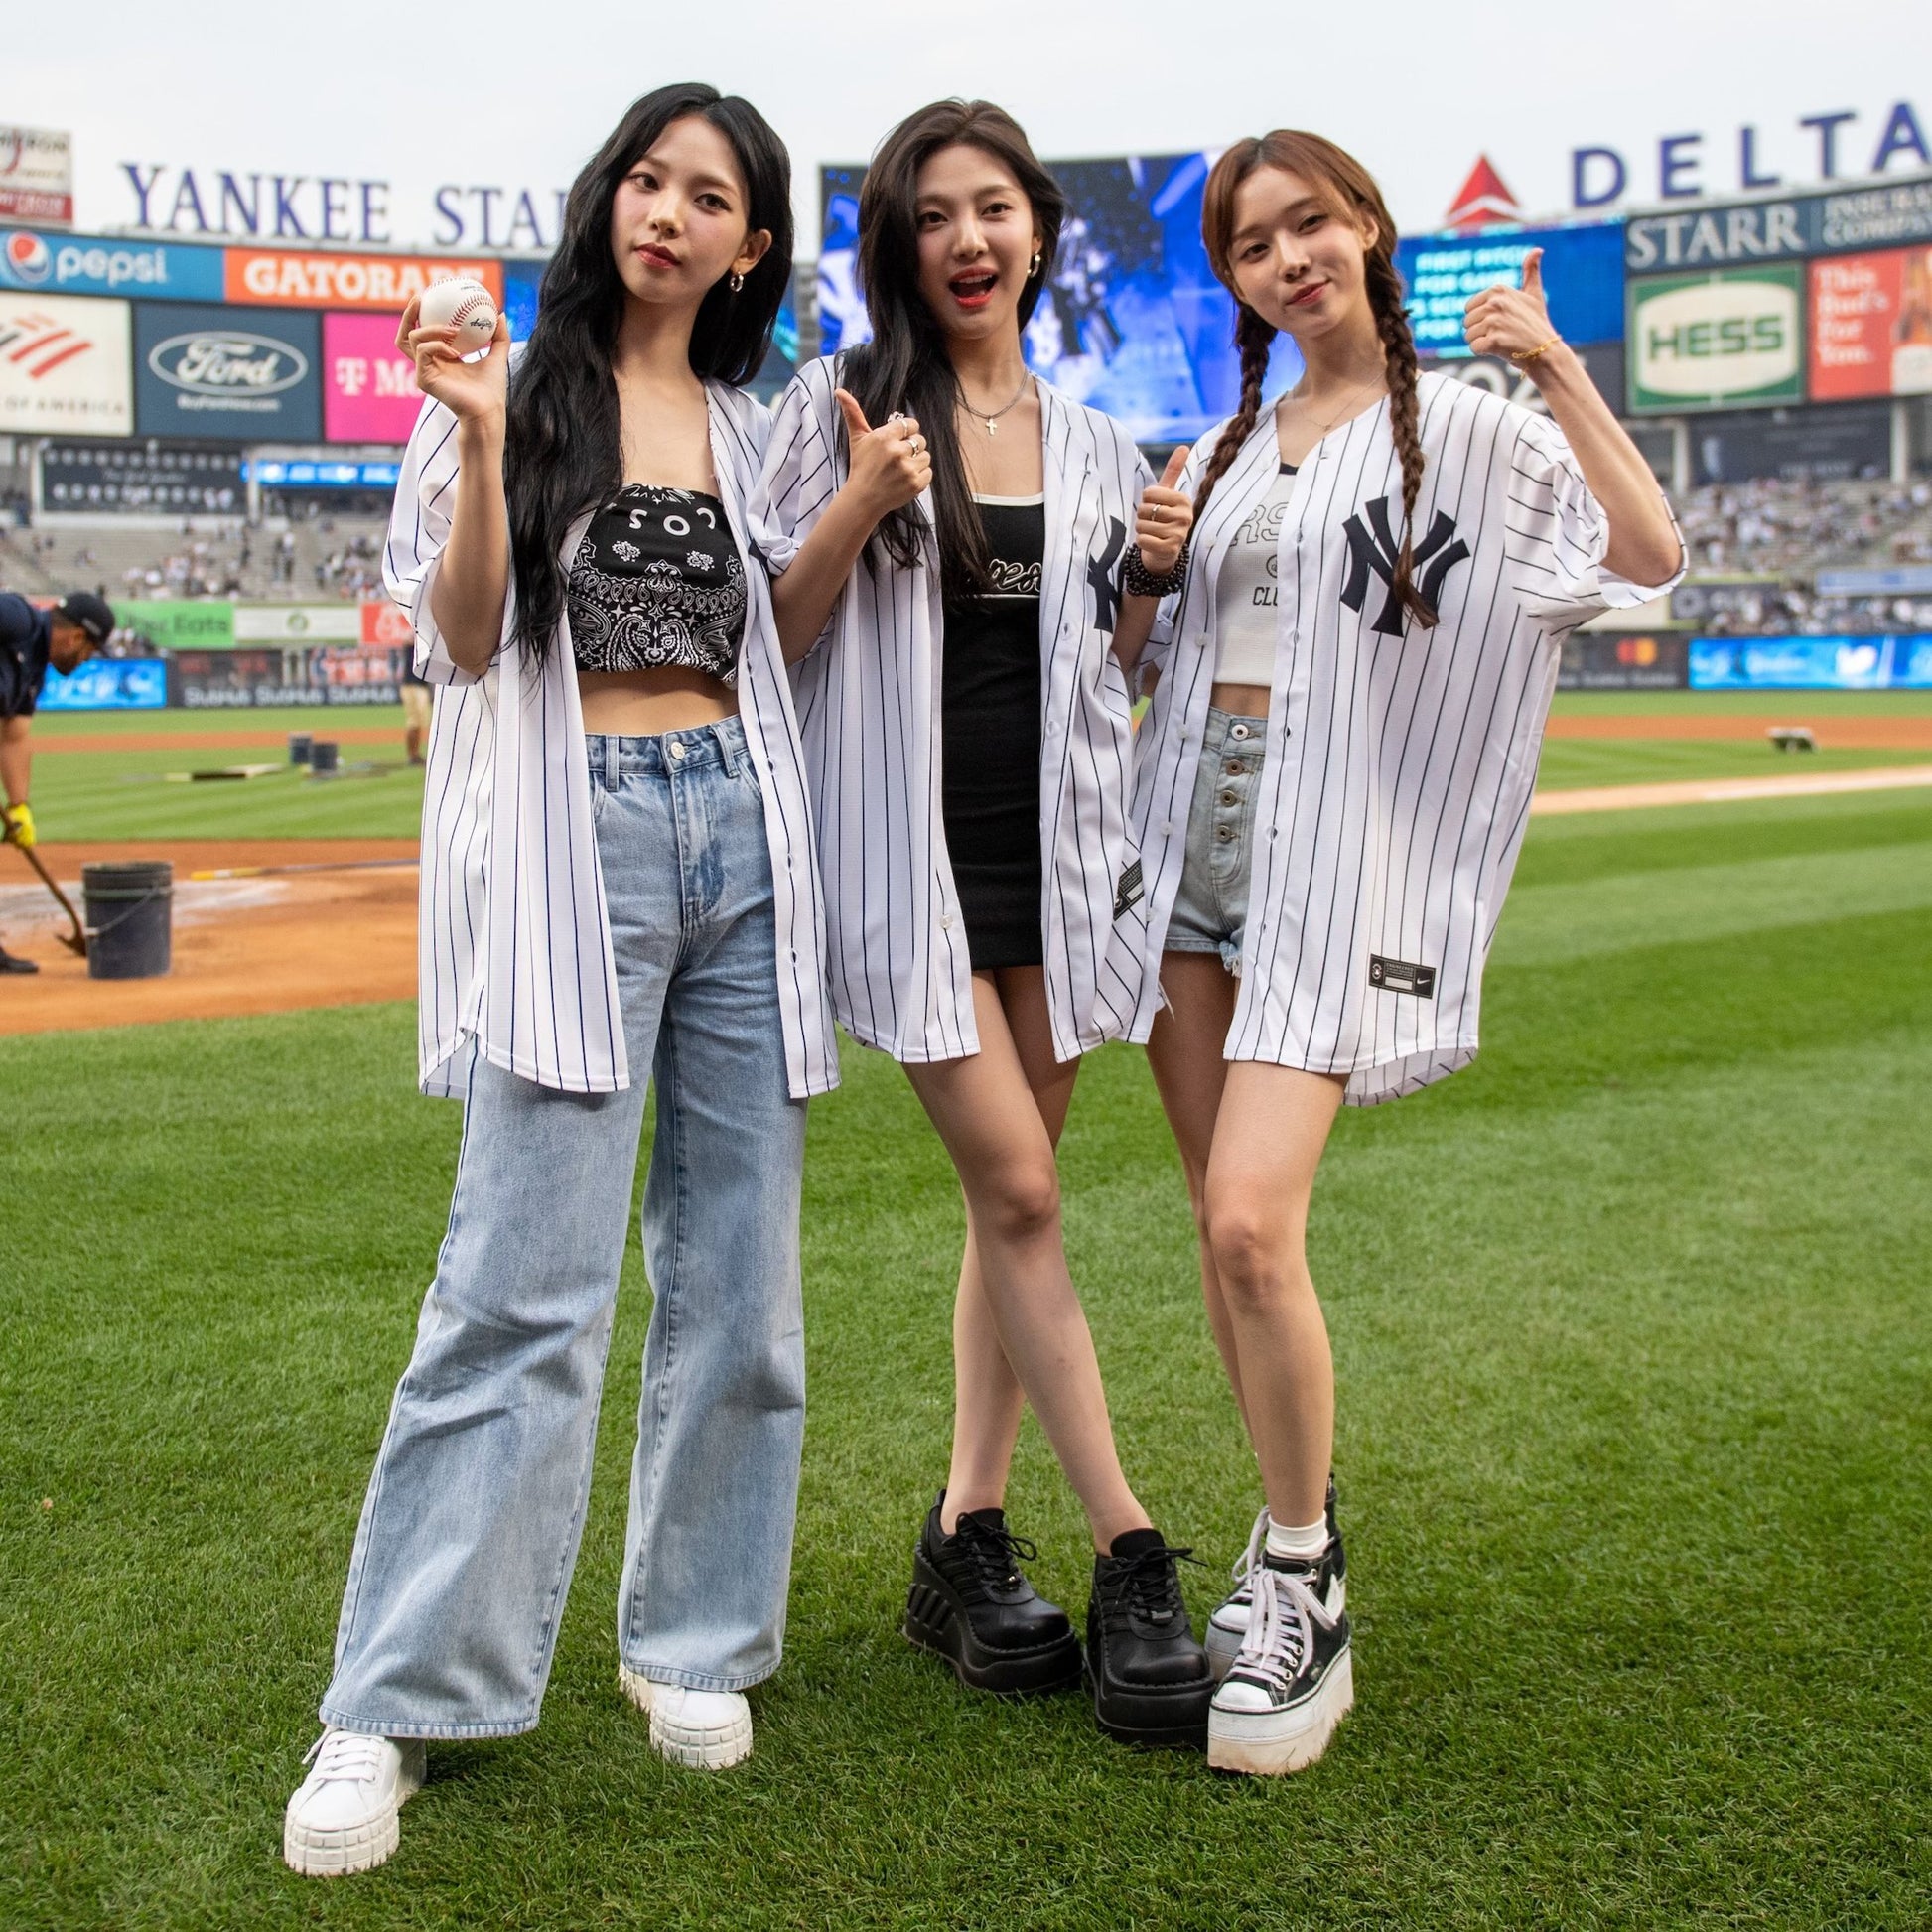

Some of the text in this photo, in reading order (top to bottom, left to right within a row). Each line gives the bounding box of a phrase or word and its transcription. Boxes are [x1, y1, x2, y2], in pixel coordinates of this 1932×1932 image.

[1572, 100, 1932, 208] DELTA
[119, 161, 391, 244] YANKEE
[1628, 206, 1804, 269] STARR
[56, 245, 168, 288] pepsi
[1647, 317, 1784, 360] HESS
[177, 340, 279, 384] Ford
[37, 400, 124, 415] AMERICA
